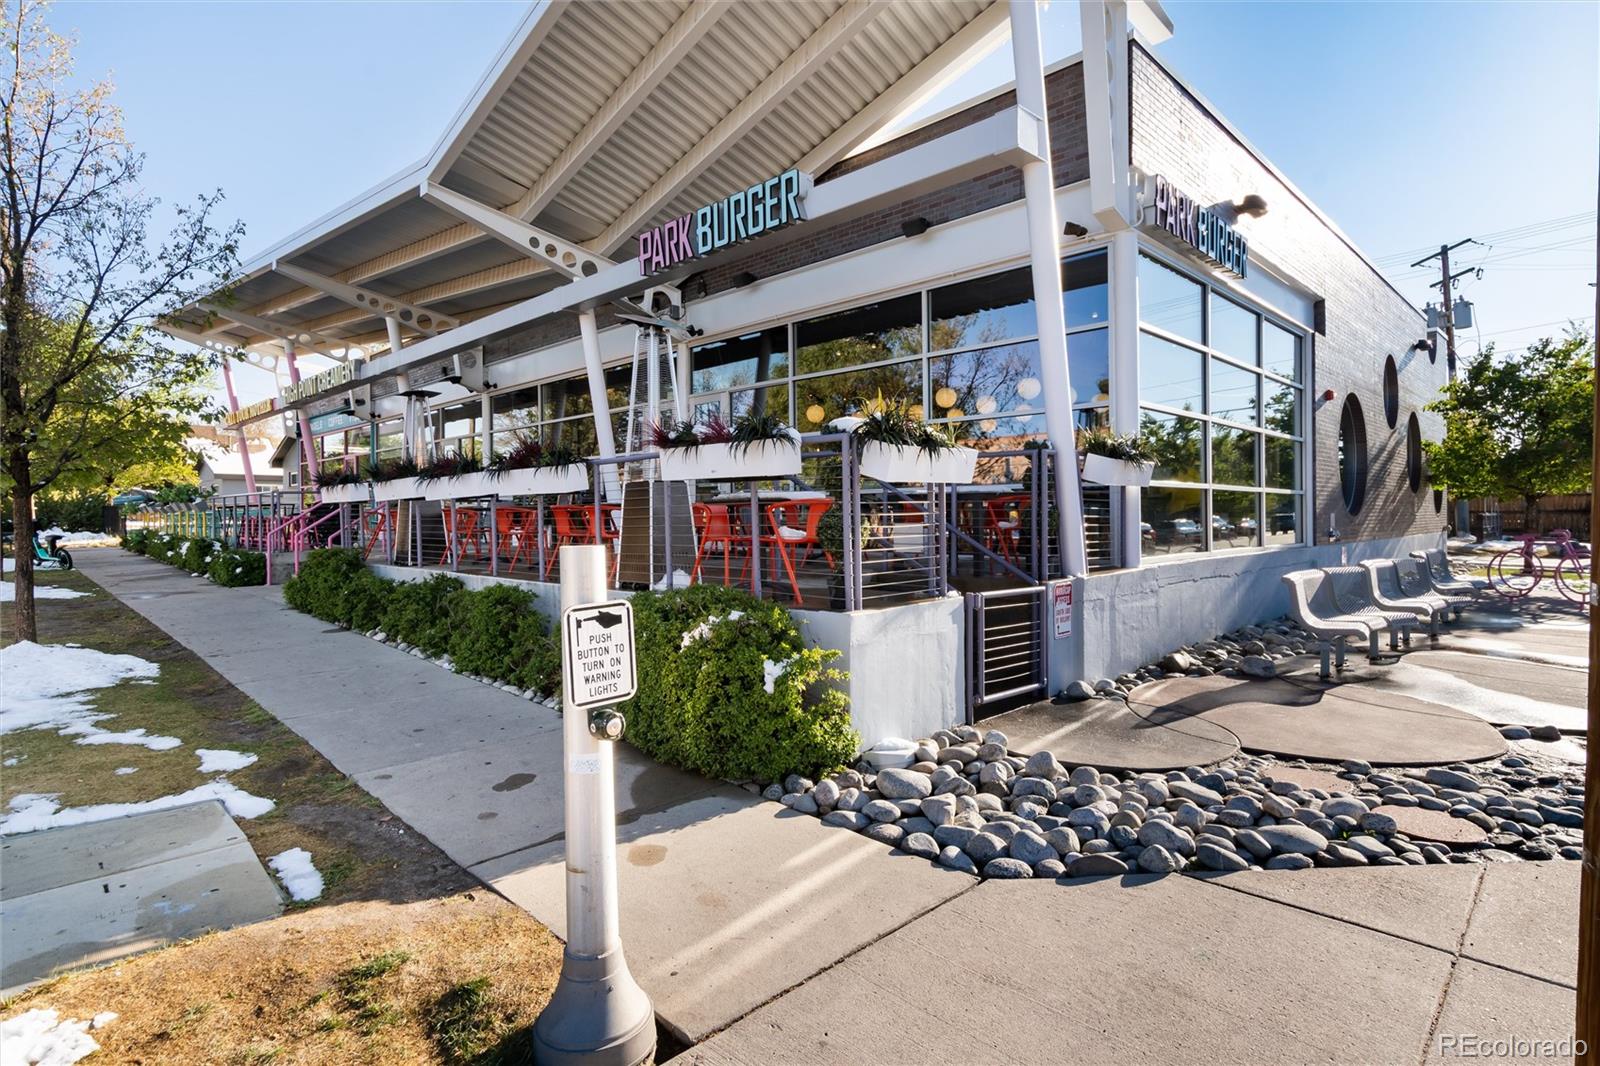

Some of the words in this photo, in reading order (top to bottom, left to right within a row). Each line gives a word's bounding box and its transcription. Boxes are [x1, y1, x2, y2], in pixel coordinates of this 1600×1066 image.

[638, 212, 693, 276] PARK
[696, 168, 800, 255] BURGER
[1155, 174, 1198, 249] PARK
[1197, 206, 1248, 280] BURGER
[318, 360, 356, 392] CREAMERY
[589, 633, 612, 645] PUSH
[577, 646, 610, 660] BUTTON
[614, 643, 625, 654] TO
[582, 661, 605, 673] TURN
[609, 657, 622, 668] ON
[583, 669, 622, 686] WARNING
[588, 683, 618, 698] LIGHTS
